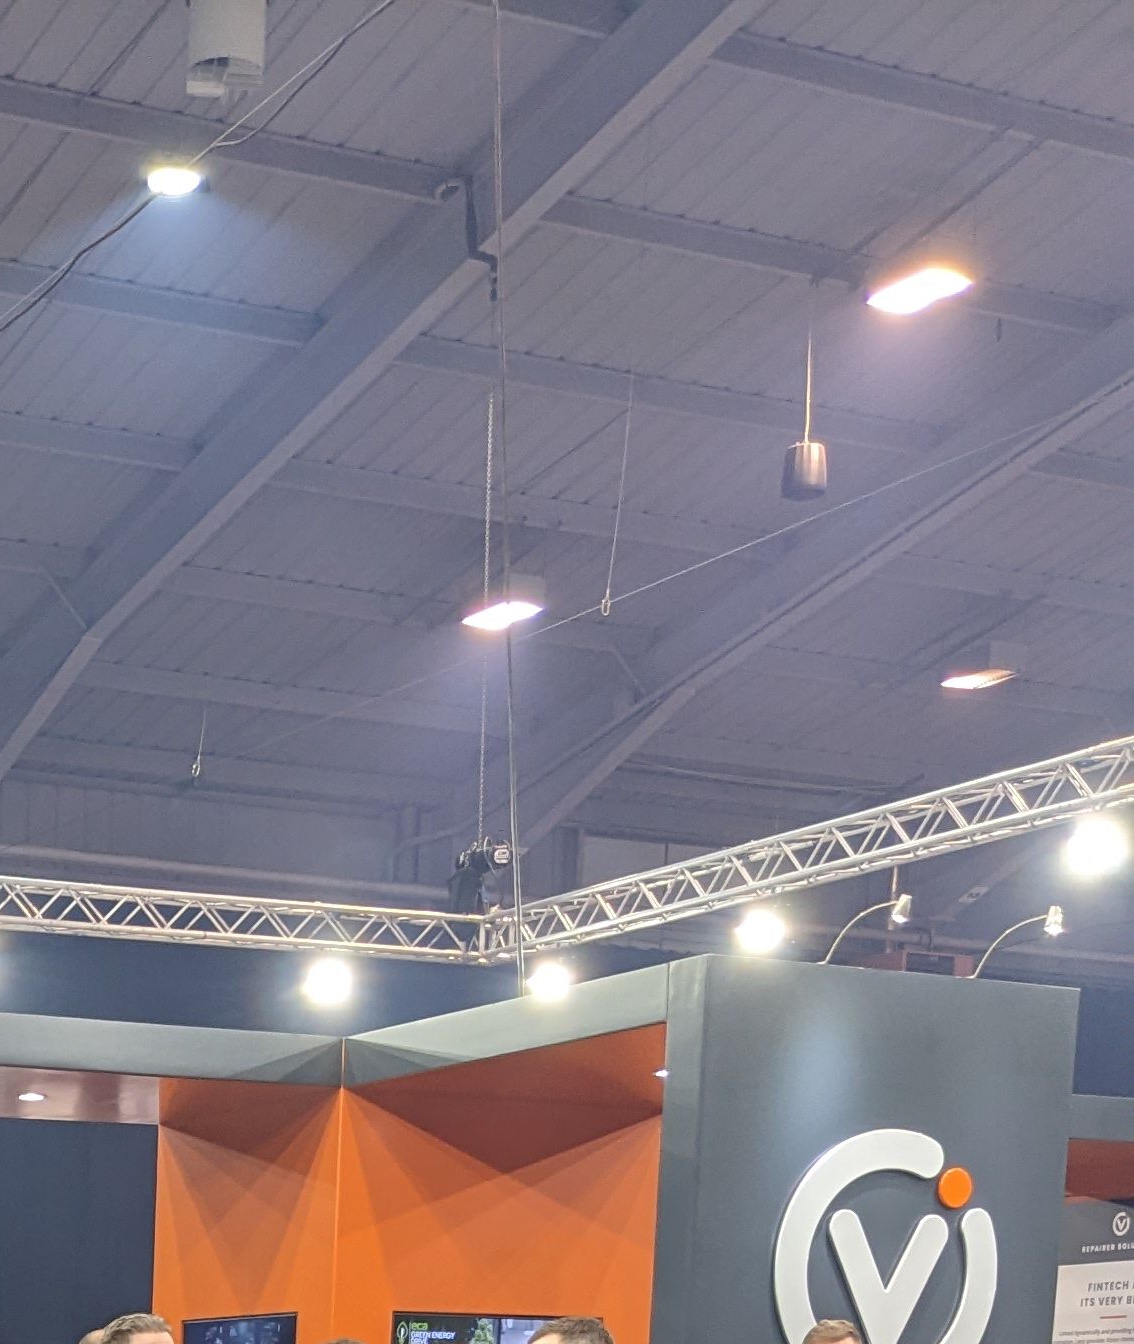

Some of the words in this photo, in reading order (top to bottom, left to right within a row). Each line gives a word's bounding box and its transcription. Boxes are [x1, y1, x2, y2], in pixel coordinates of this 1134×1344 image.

[1081, 1243, 1116, 1253] REPAIRER
[1088, 1281, 1129, 1292] FINTECH
[1080, 1298, 1095, 1307] ITS
[1097, 1296, 1123, 1306] VERY
